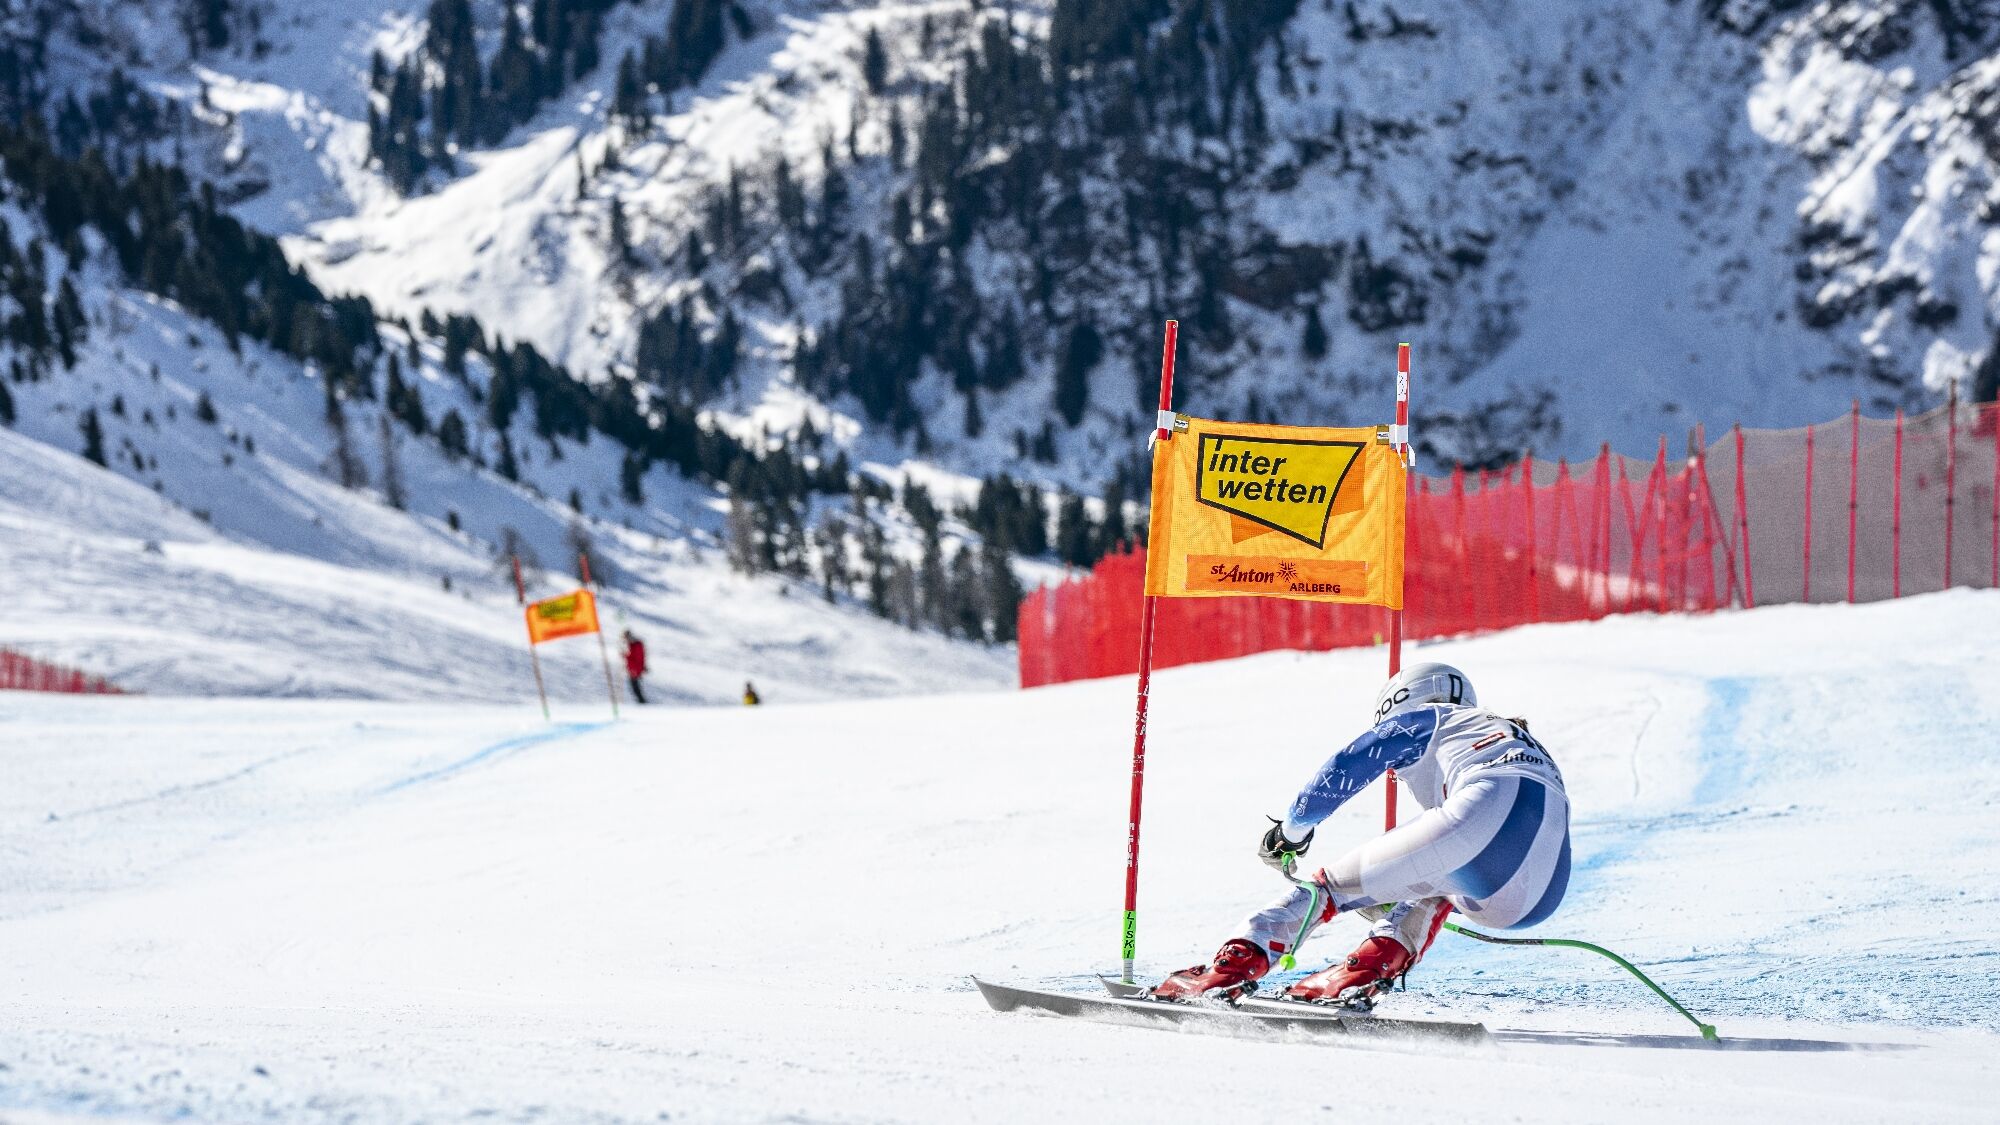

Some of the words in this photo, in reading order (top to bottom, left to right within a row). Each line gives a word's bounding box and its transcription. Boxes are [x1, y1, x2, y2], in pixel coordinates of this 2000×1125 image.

[1208, 440, 1287, 476] inter
[1218, 479, 1326, 504] wetten
[1289, 582, 1341, 594] ARLBERG
[1124, 911, 1135, 959] LISKI
